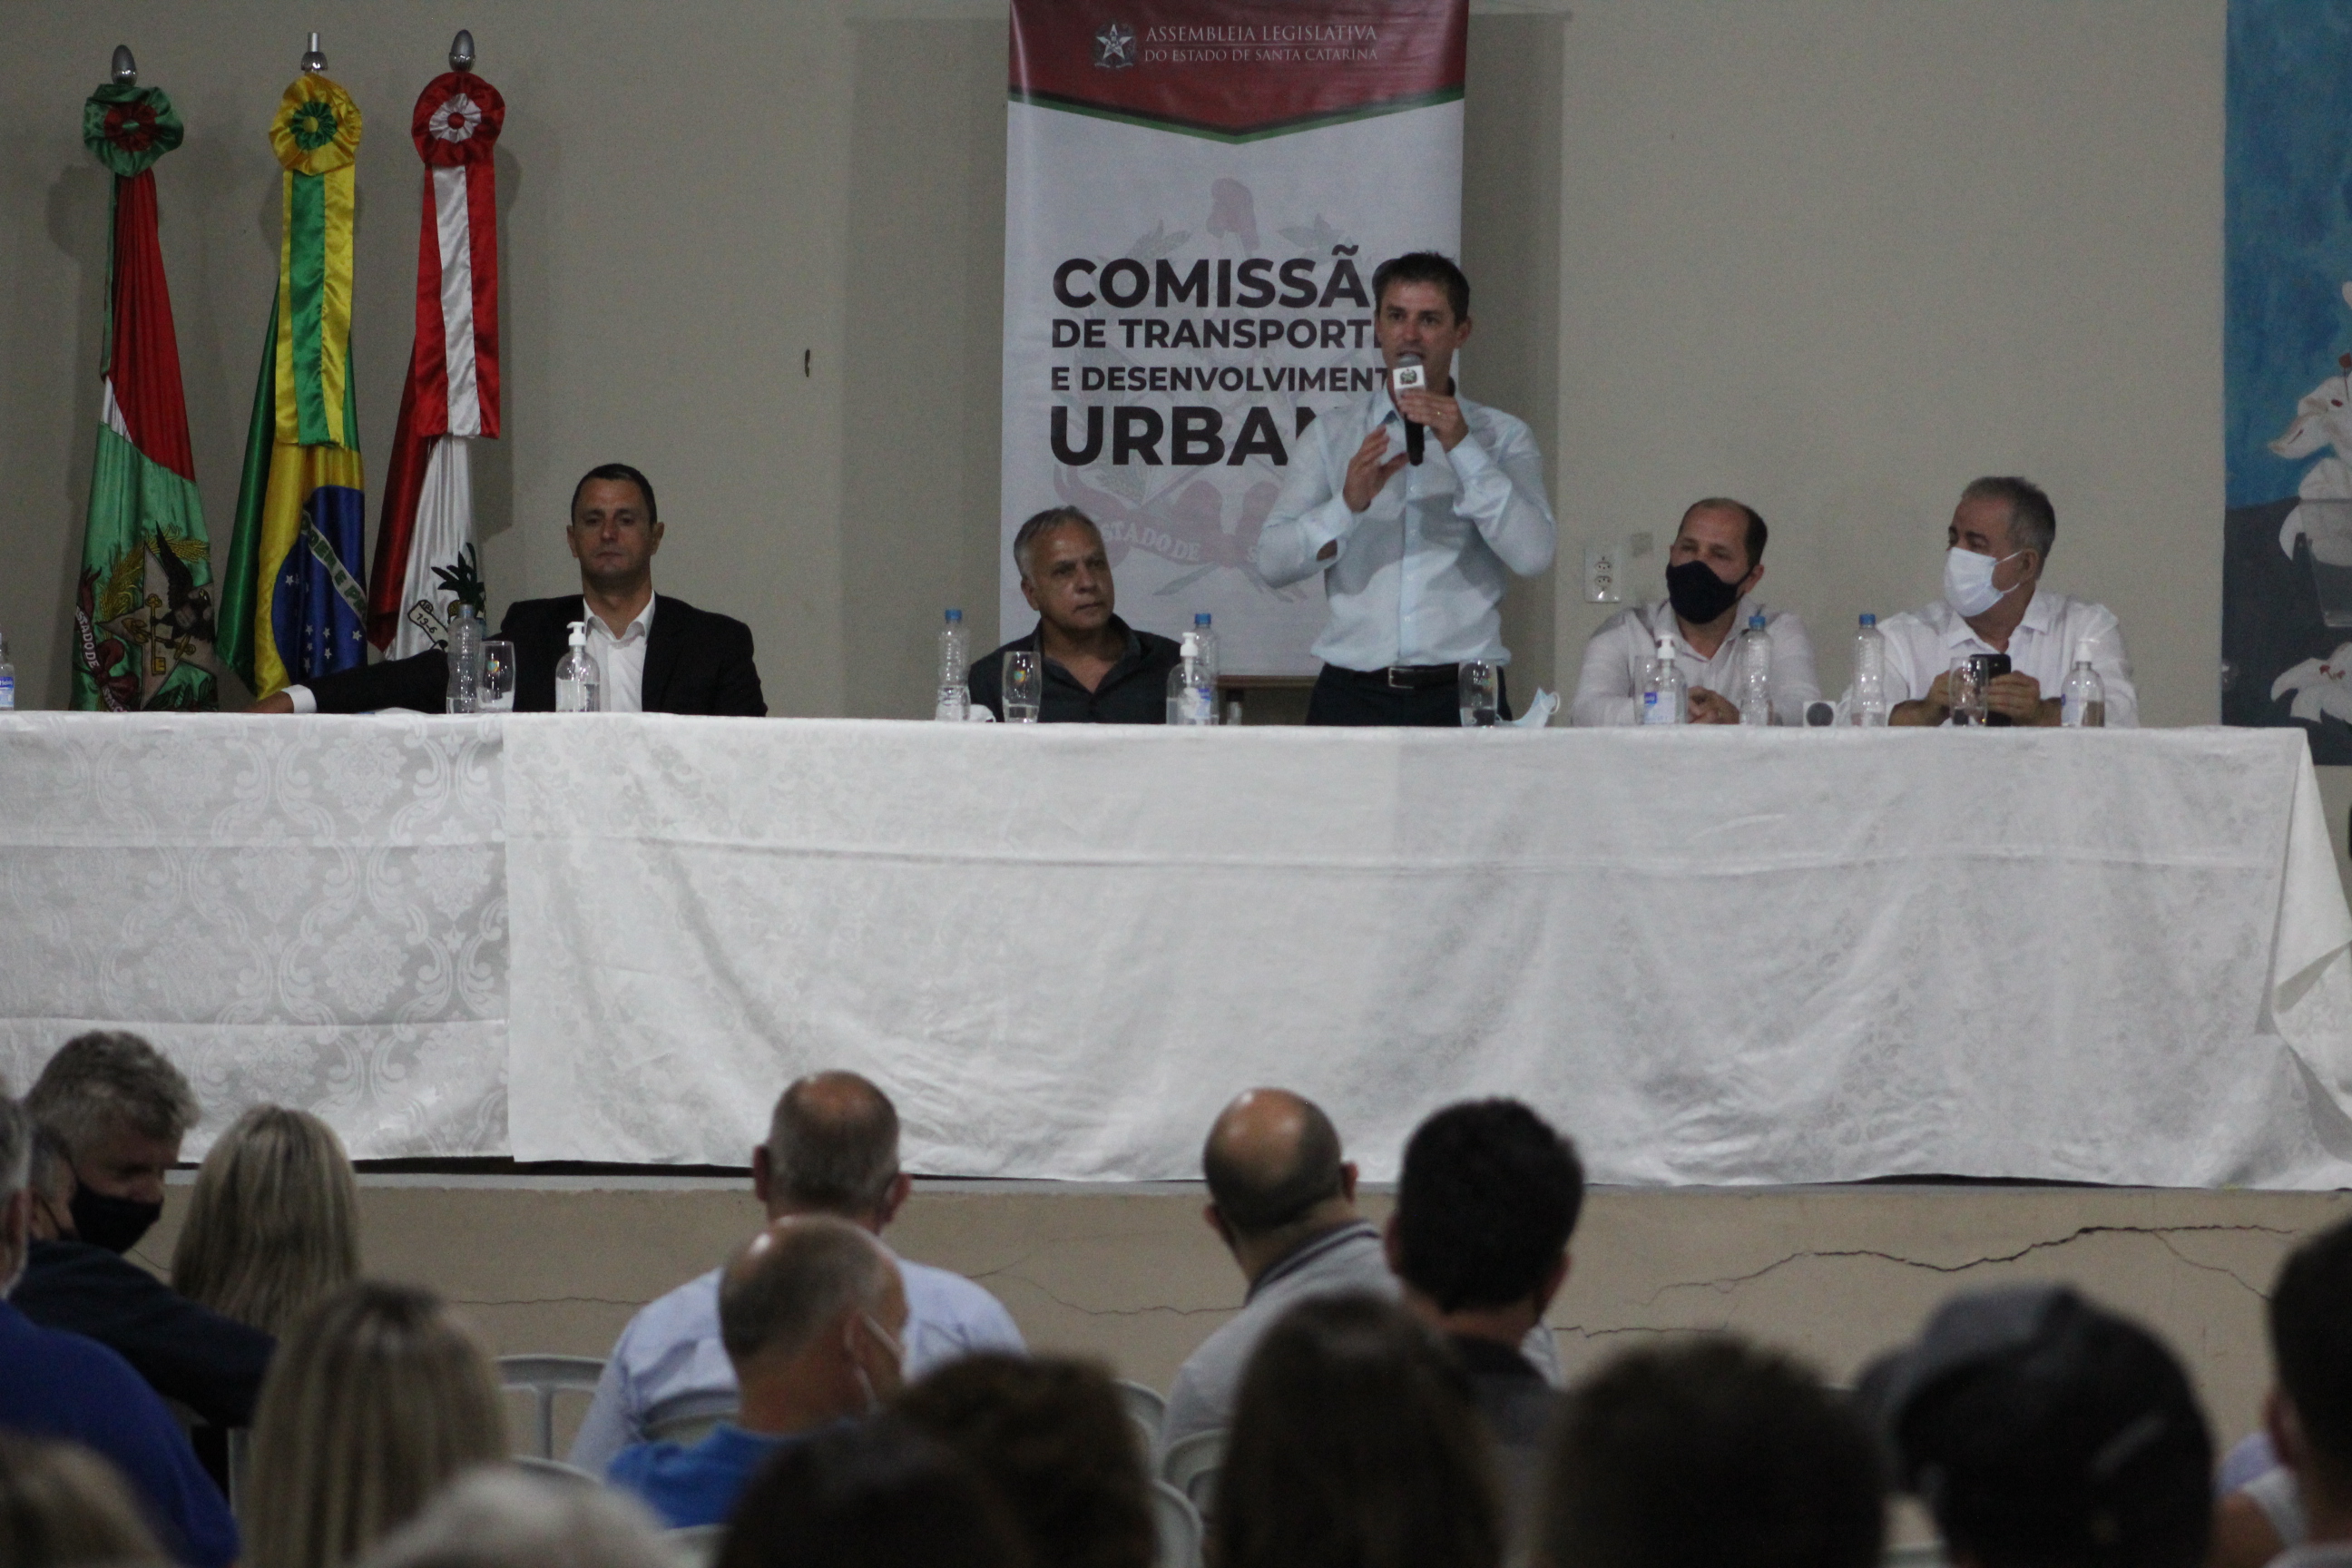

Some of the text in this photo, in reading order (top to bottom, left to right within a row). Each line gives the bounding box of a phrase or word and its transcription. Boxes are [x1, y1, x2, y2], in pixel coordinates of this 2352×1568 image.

[1145, 24, 1377, 42] ASSEMBLEIA LEGISLATIVA
[1144, 48, 1378, 62] DO ESTADO DE SANTA CATARINA
[1051, 318, 1382, 349] DE TRANSPORT
[1051, 367, 1071, 391] E
